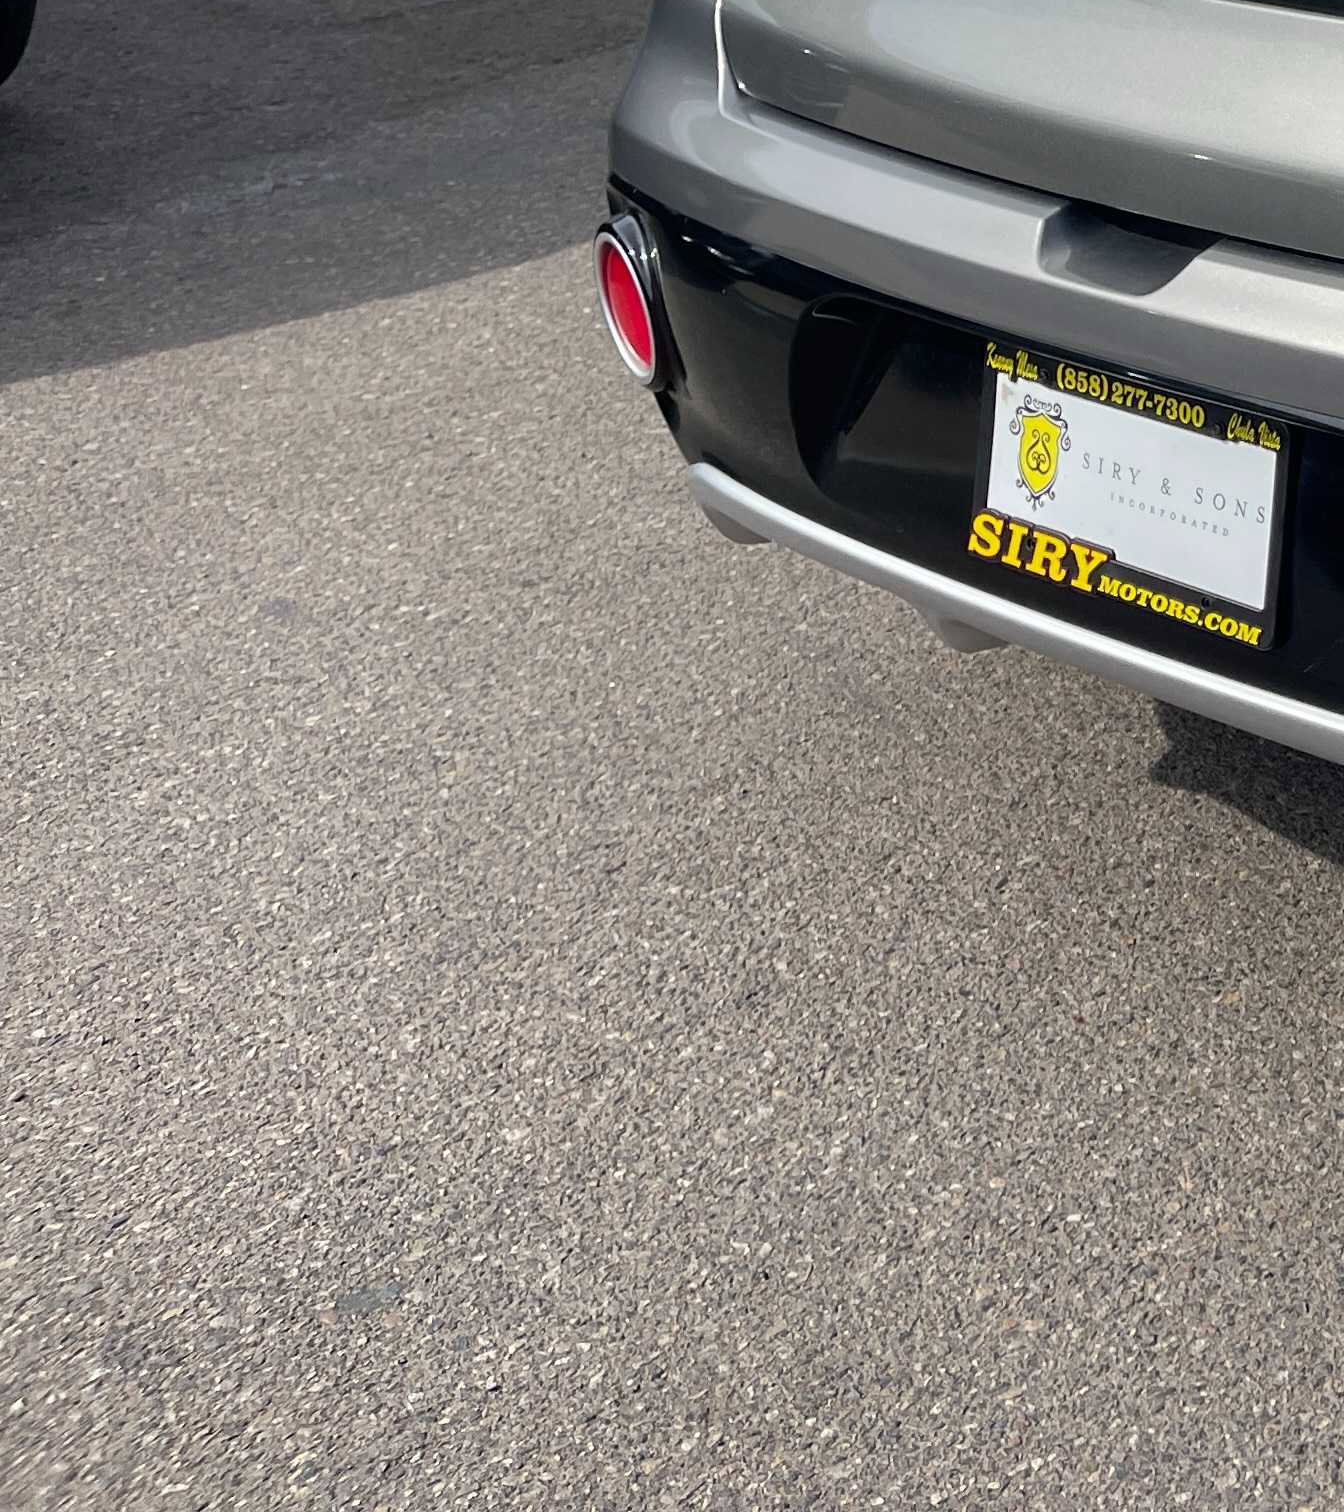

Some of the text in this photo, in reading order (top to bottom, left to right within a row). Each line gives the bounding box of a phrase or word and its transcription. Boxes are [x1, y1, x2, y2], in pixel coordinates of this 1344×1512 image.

[1056, 362, 1206, 429] (858) 277-7300
[1081, 452, 1266, 524] SIRY & SONS
[1110, 491, 1230, 537] INCORPORATED
[967, 511, 1263, 647] SIRY MOTORS.COM
